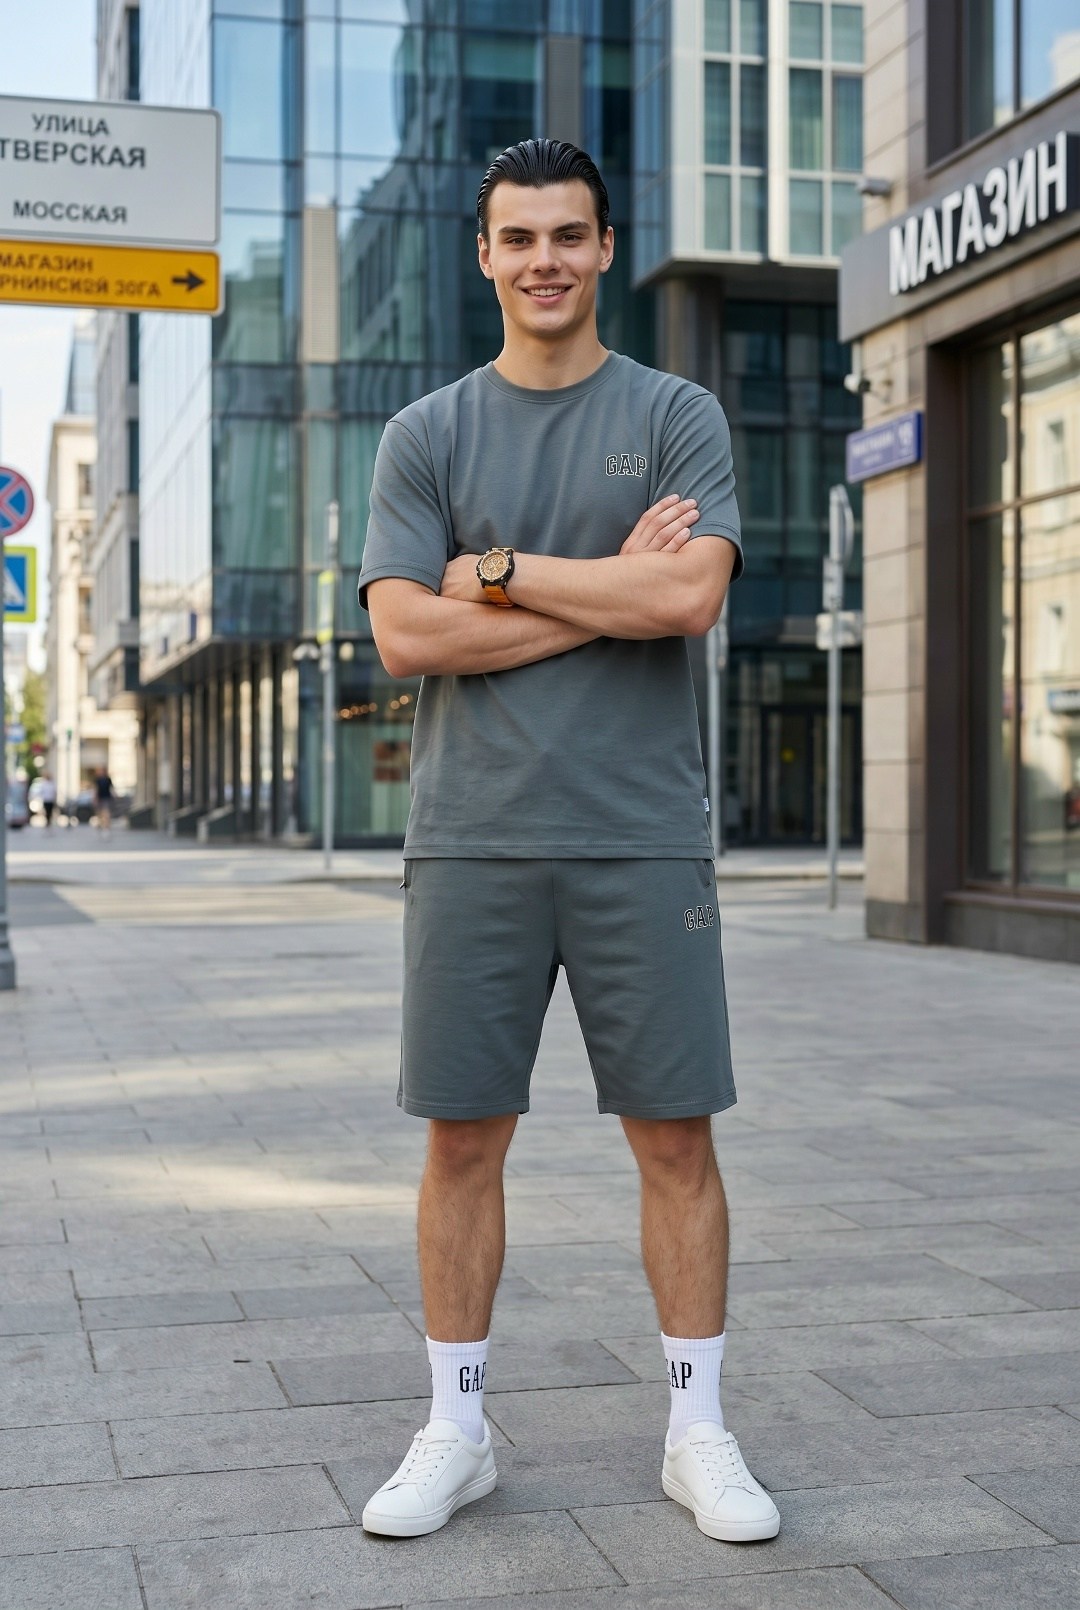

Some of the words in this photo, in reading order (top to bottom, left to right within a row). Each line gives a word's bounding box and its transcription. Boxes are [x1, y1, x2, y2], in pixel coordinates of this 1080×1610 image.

[32, 113, 109, 136] УЛИЦА
[0, 138, 147, 168] ТВЕРСКАЯ
[13, 200, 128, 223] МОССКАЯ
[889, 130, 1067, 296] МАГАЗИН
[605, 453, 647, 477] GAP
[684, 904, 714, 931] GAP
